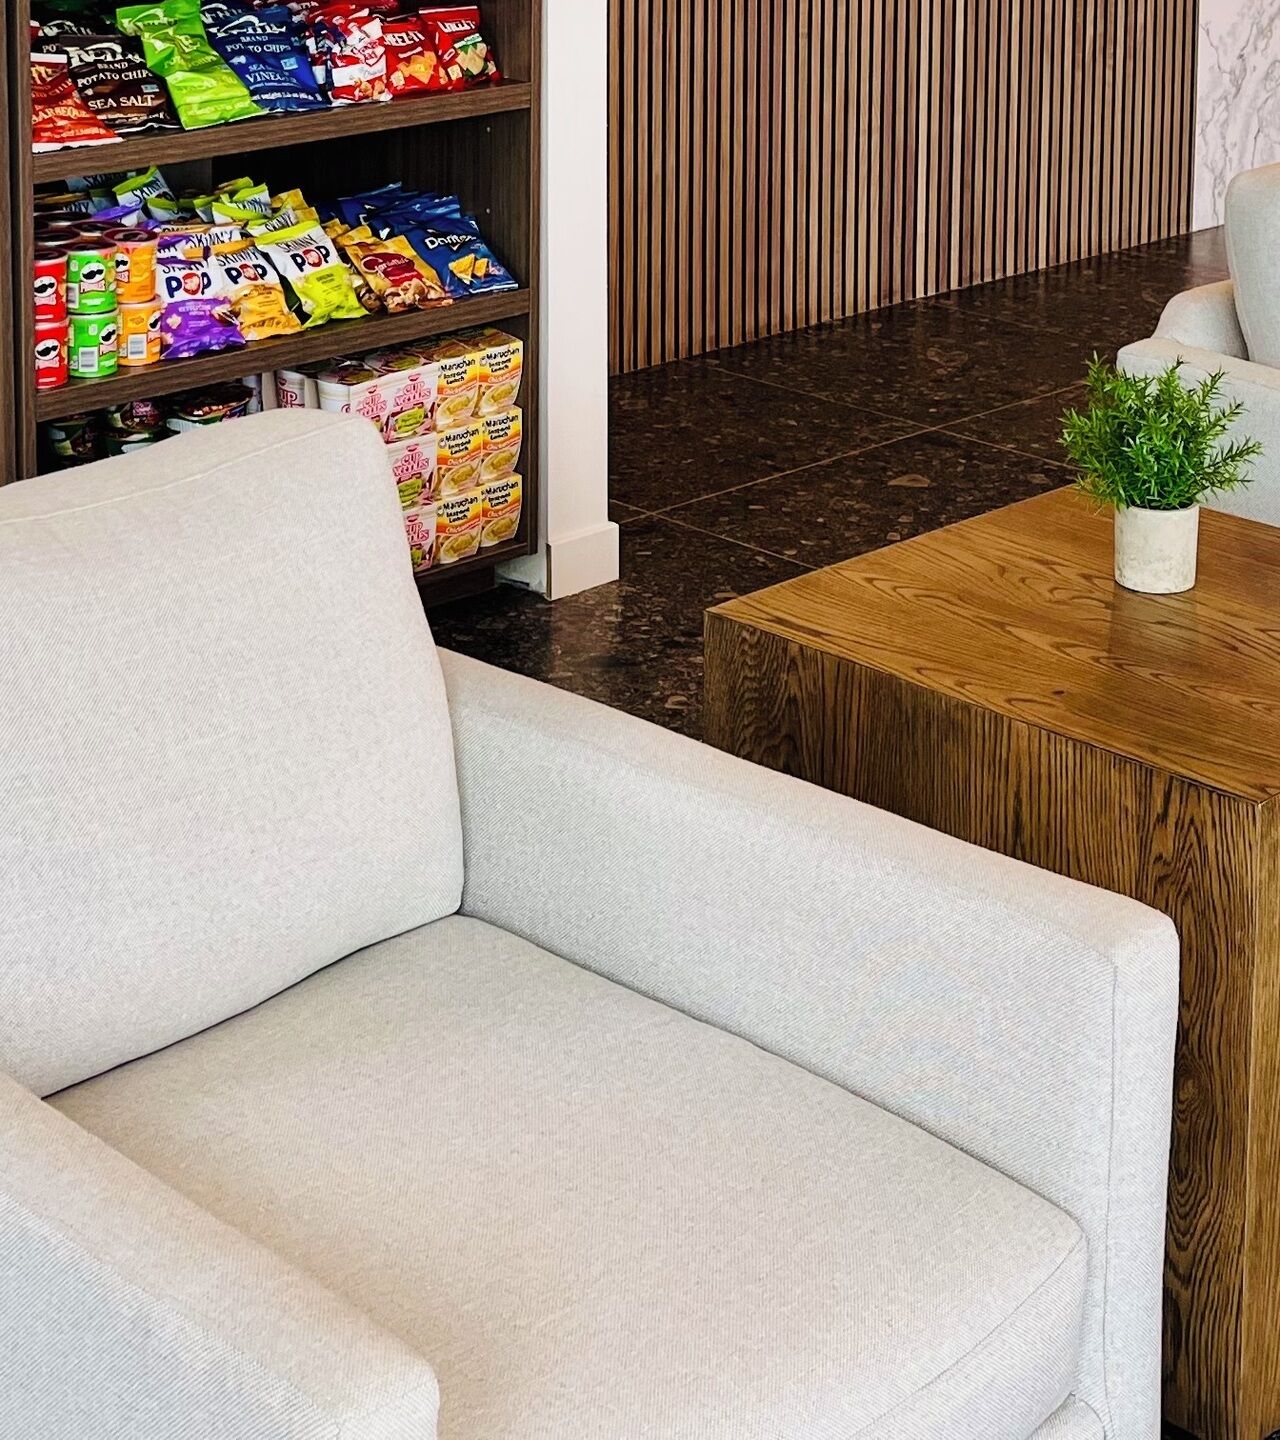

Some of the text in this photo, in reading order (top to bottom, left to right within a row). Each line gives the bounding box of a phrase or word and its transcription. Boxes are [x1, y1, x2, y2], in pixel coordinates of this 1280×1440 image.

[225, 43, 262, 53] POTTO
[77, 71, 120, 88] POTATO
[88, 97, 118, 111] SEA
[120, 94, 156, 107] SALT
[189, 230, 234, 249] SKINNY
[276, 233, 320, 253] SKINNY
[215, 246, 260, 267] SKINNY
[290, 245, 331, 273] POP
[225, 263, 268, 285] POP
[166, 272, 212, 299] POP
[486, 348, 520, 360] Maruchan
[441, 359, 476, 372] Maruchan
[280, 390, 298, 405] UP
[485, 414, 519, 428] Maruchan
[445, 427, 480, 443] Maruchan
[485, 481, 519, 495] Maruchan
[443, 495, 478, 511] Maruchan
